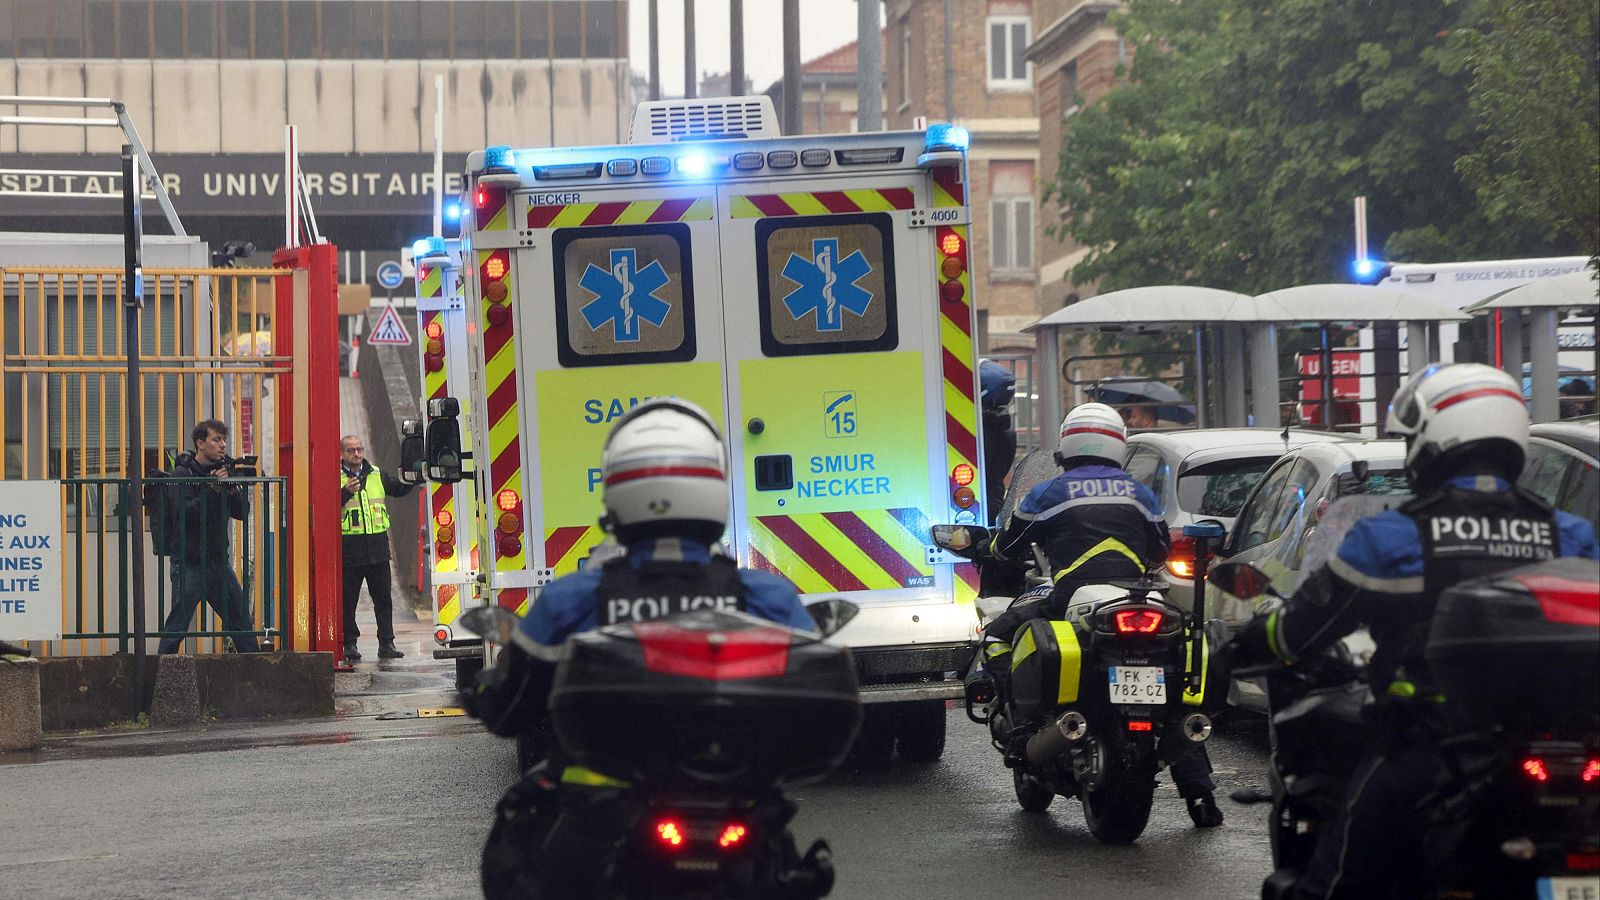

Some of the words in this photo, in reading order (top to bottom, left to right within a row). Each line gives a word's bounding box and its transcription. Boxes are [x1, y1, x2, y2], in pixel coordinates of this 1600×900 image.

[1, 173, 182, 196] SPITALER
[203, 172, 462, 196] UNIVRSITAIRE
[528, 193, 581, 206] NECKER
[931, 210, 958, 221] 4000
[831, 412, 856, 434] 15
[810, 453, 875, 474] SMUR
[797, 476, 891, 498] NECKER
[1068, 478, 1137, 499] POLICE
[1431, 516, 1552, 545] POLICE
[9, 535, 51, 549] AUX
[1113, 684, 1163, 697] 782-CZ
